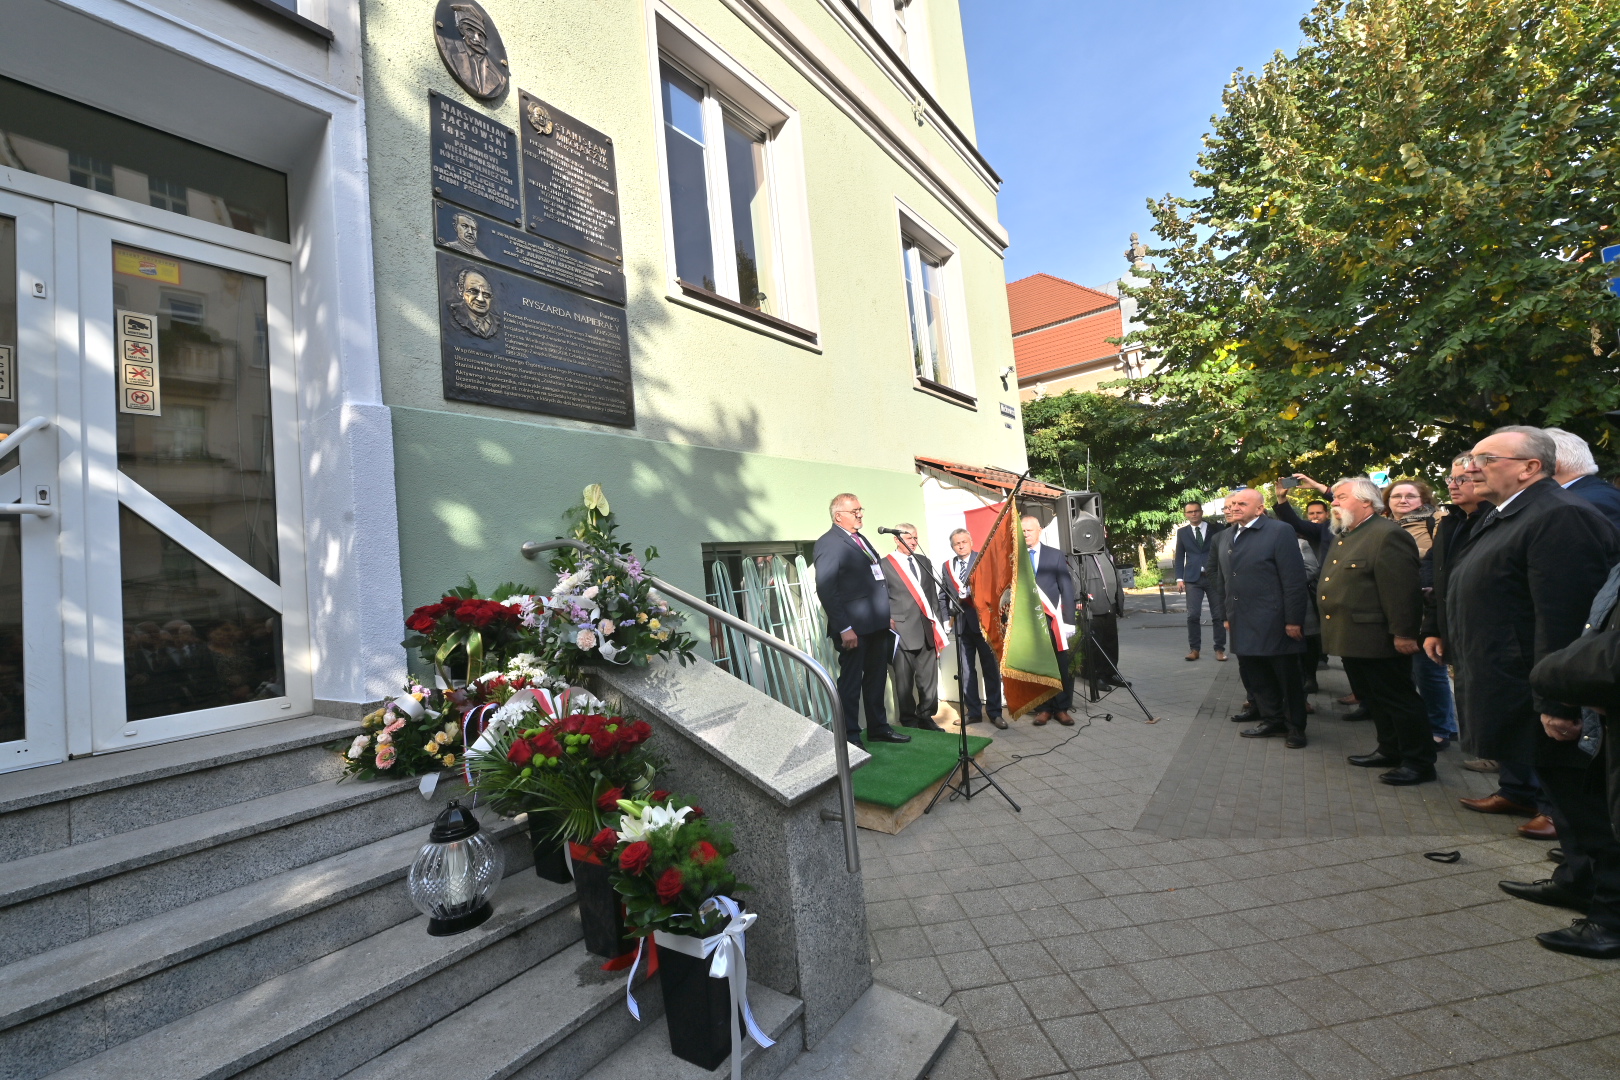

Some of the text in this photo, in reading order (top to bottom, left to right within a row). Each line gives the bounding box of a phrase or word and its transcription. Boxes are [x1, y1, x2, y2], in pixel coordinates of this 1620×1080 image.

[440, 100, 506, 140] MAKSYMILIAN
[441, 111, 507, 150] JACKOWSKI
[441, 122, 466, 140] 1815
[484, 142, 508, 160] 1905
[454, 140, 498, 164] PATRONOWI
[554, 122, 607, 156] STANISŁAW
[555, 132, 608, 164] MIKOŁAJCZYK
[444, 143, 508, 176] WIELKOPOLSKICH
[469, 162, 513, 185] ROLNICZYCH
[522, 298, 620, 332] RYSZARDA NAPIERAŁY
[454, 346, 492, 358] Współtwórcy
